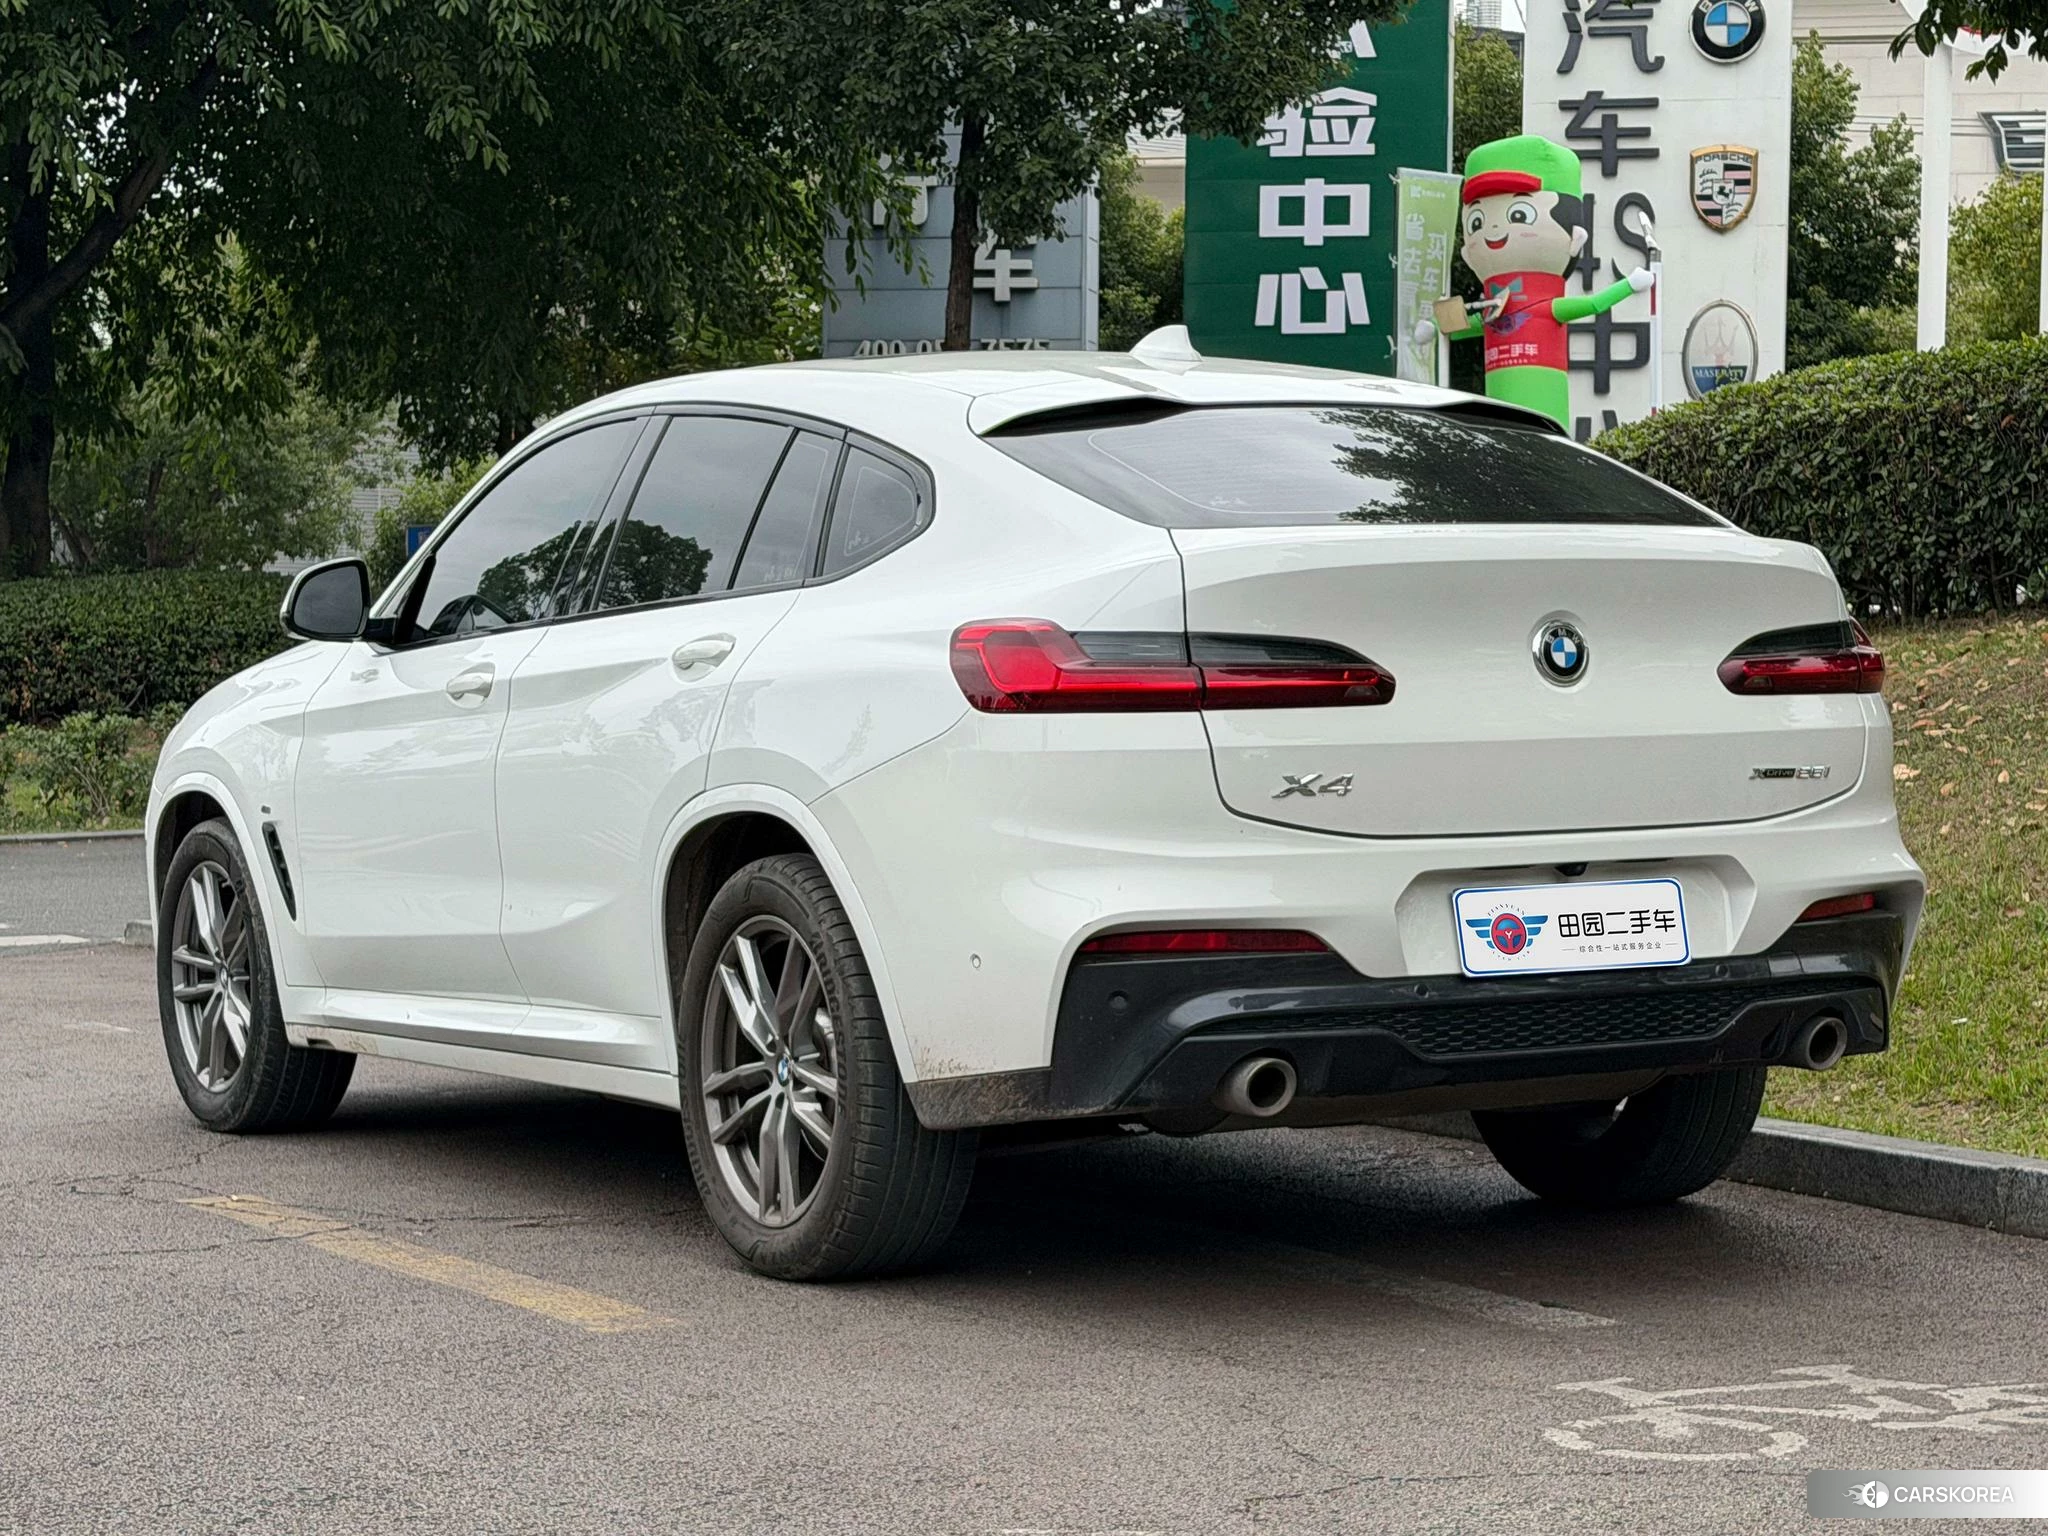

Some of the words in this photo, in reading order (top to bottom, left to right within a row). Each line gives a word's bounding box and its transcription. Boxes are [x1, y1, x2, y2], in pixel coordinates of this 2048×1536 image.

[1255, 19, 1378, 335] 验中心
[1271, 773, 1354, 799] X4
[1557, 909, 1677, 938] 田园二手车
[1579, 941, 1662, 953] 综合性一站式服务企业
